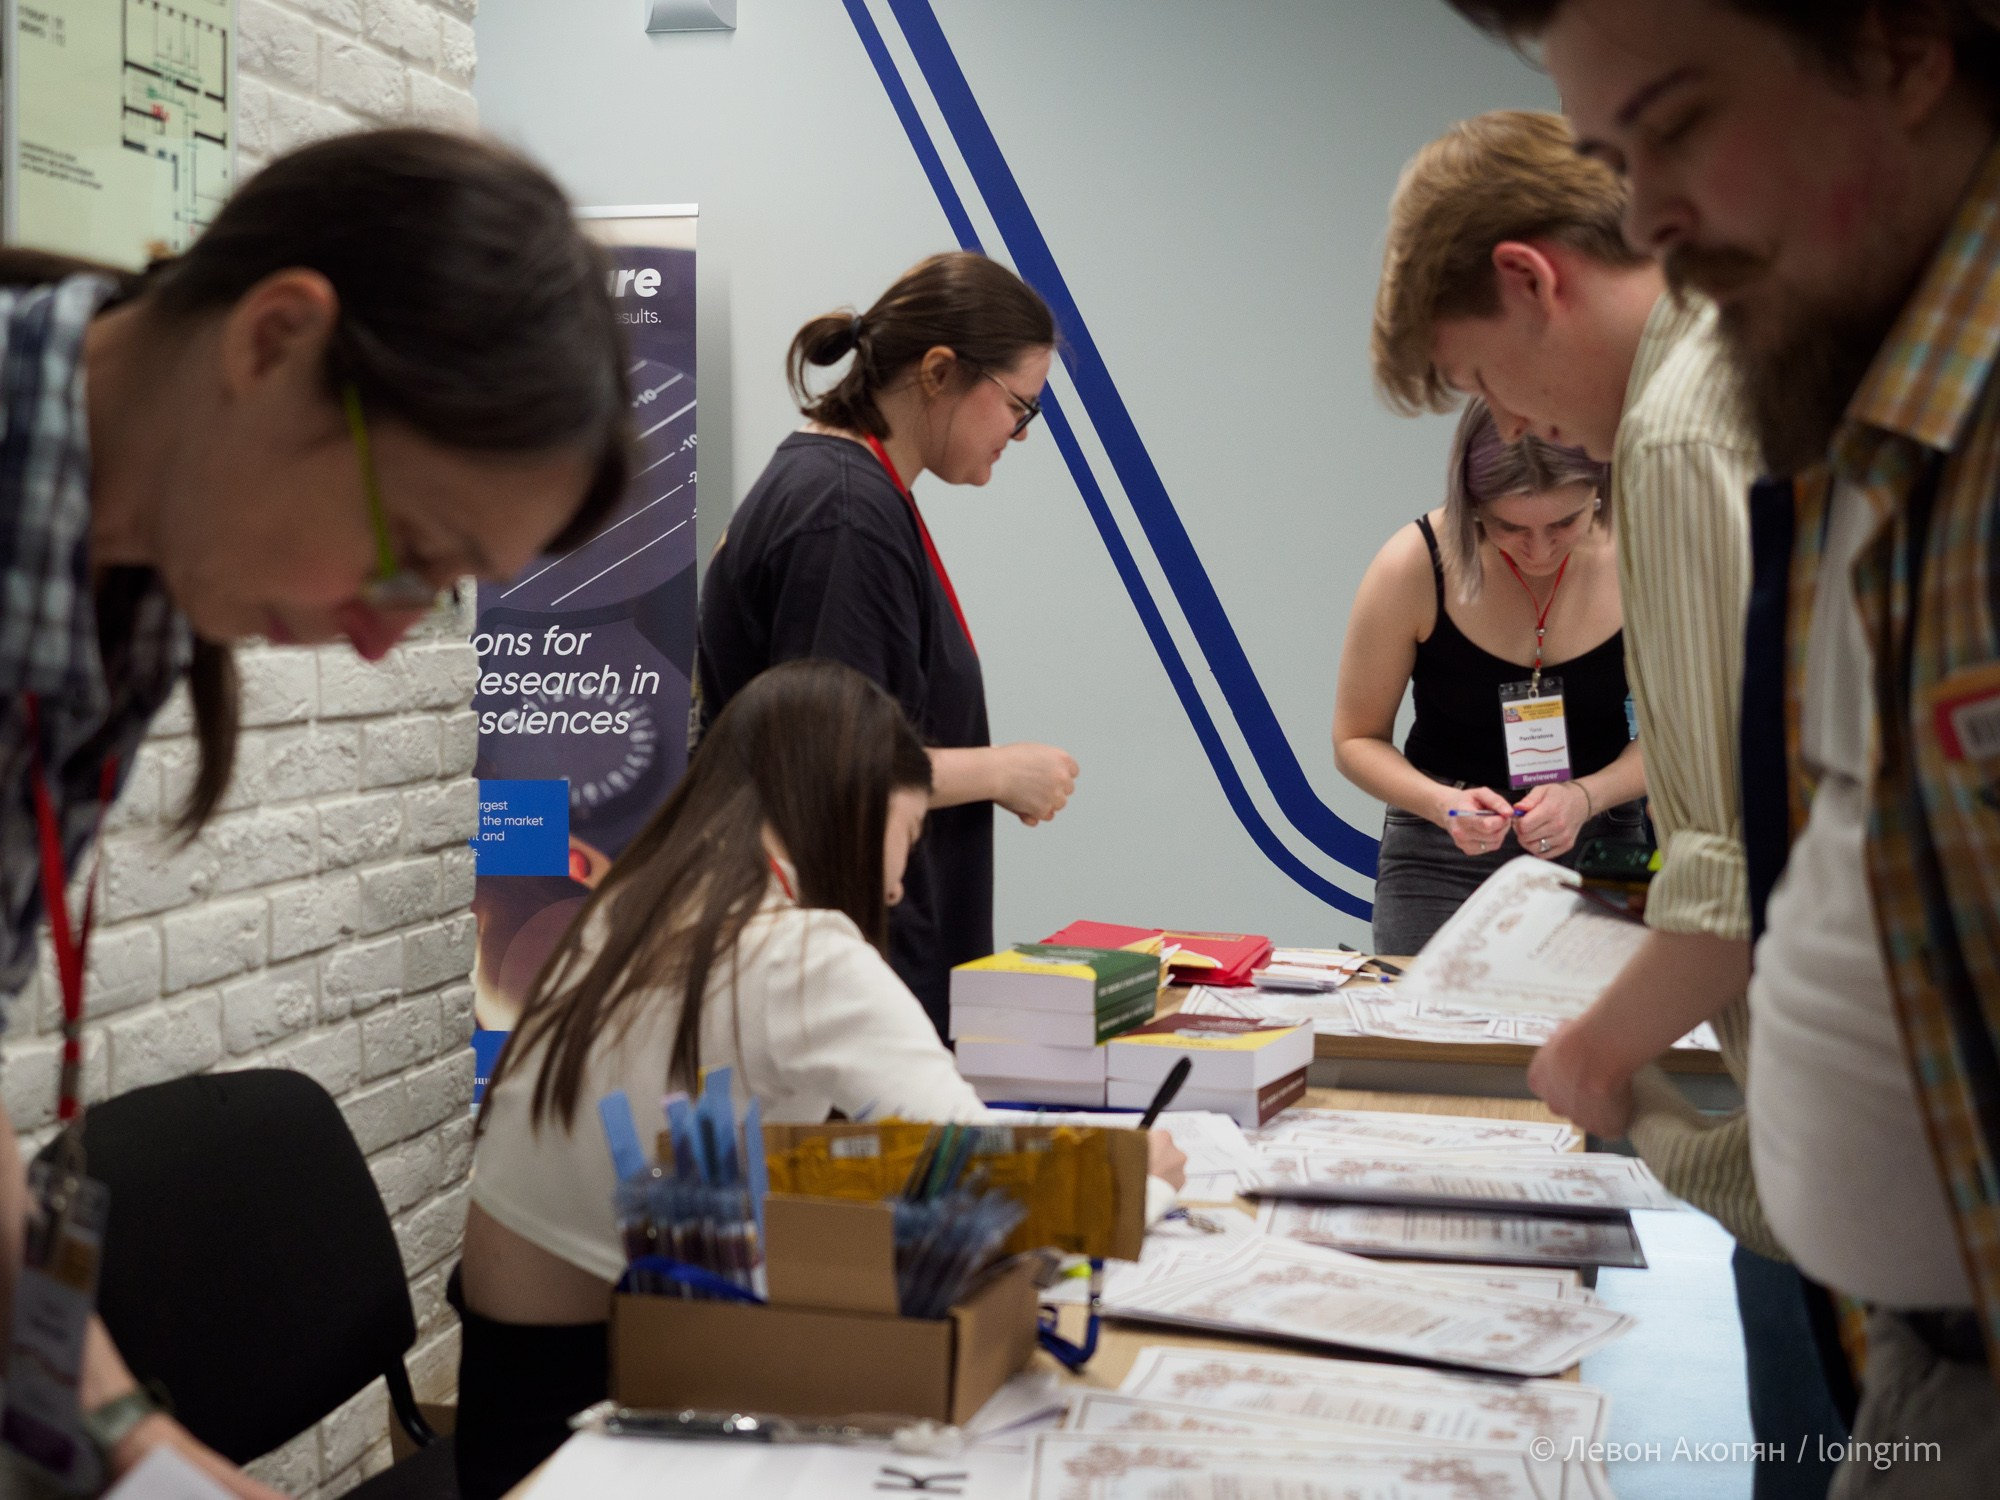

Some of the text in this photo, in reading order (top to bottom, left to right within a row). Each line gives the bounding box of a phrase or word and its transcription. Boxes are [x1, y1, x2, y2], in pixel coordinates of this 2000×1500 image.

[467, 625, 592, 656] ons for
[629, 665, 660, 695] in
[477, 801, 508, 813] rgest
[482, 815, 502, 826] the
[504, 815, 544, 826] market
[482, 830, 505, 841] and
